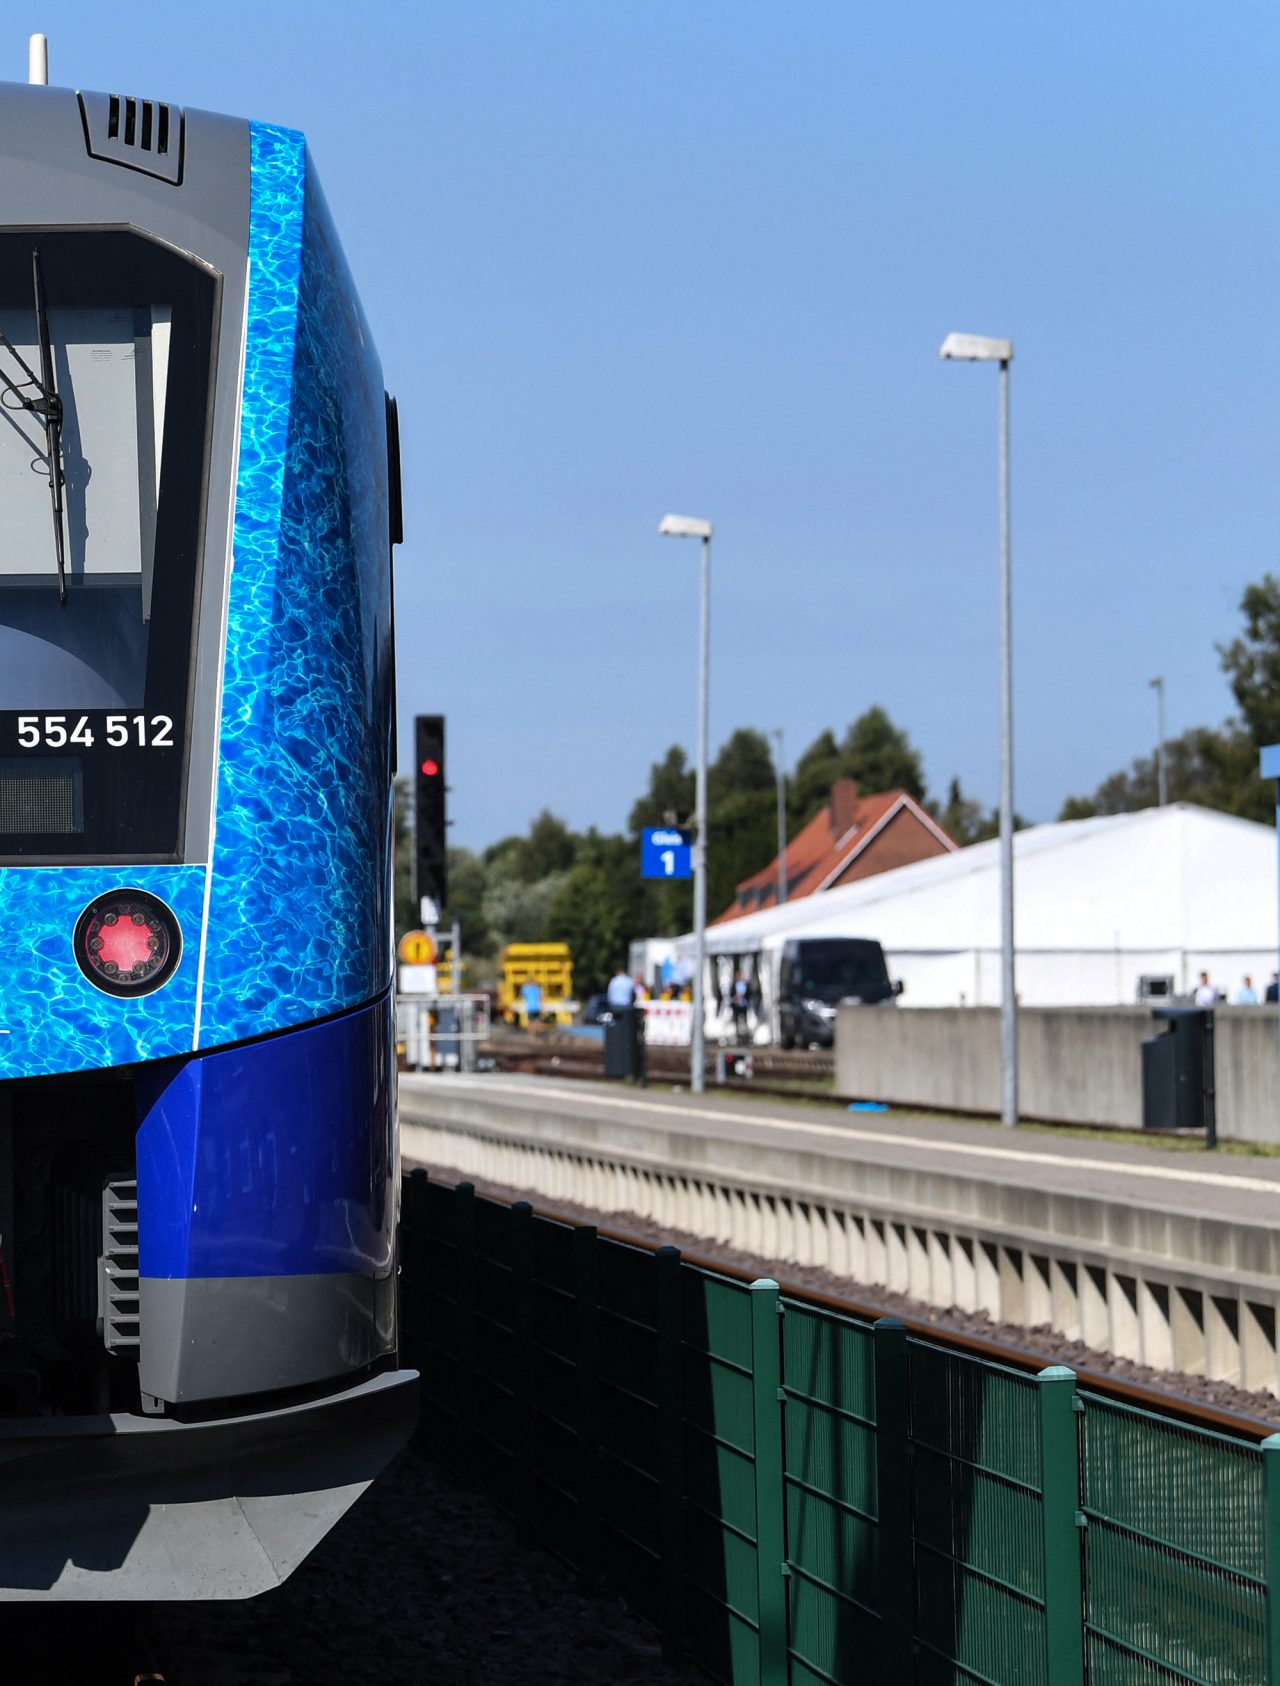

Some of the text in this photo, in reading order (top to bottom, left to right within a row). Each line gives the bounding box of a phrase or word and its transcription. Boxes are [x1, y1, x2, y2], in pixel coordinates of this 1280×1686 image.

[17, 715, 174, 748] 554 512
[660, 850, 675, 876] 1
